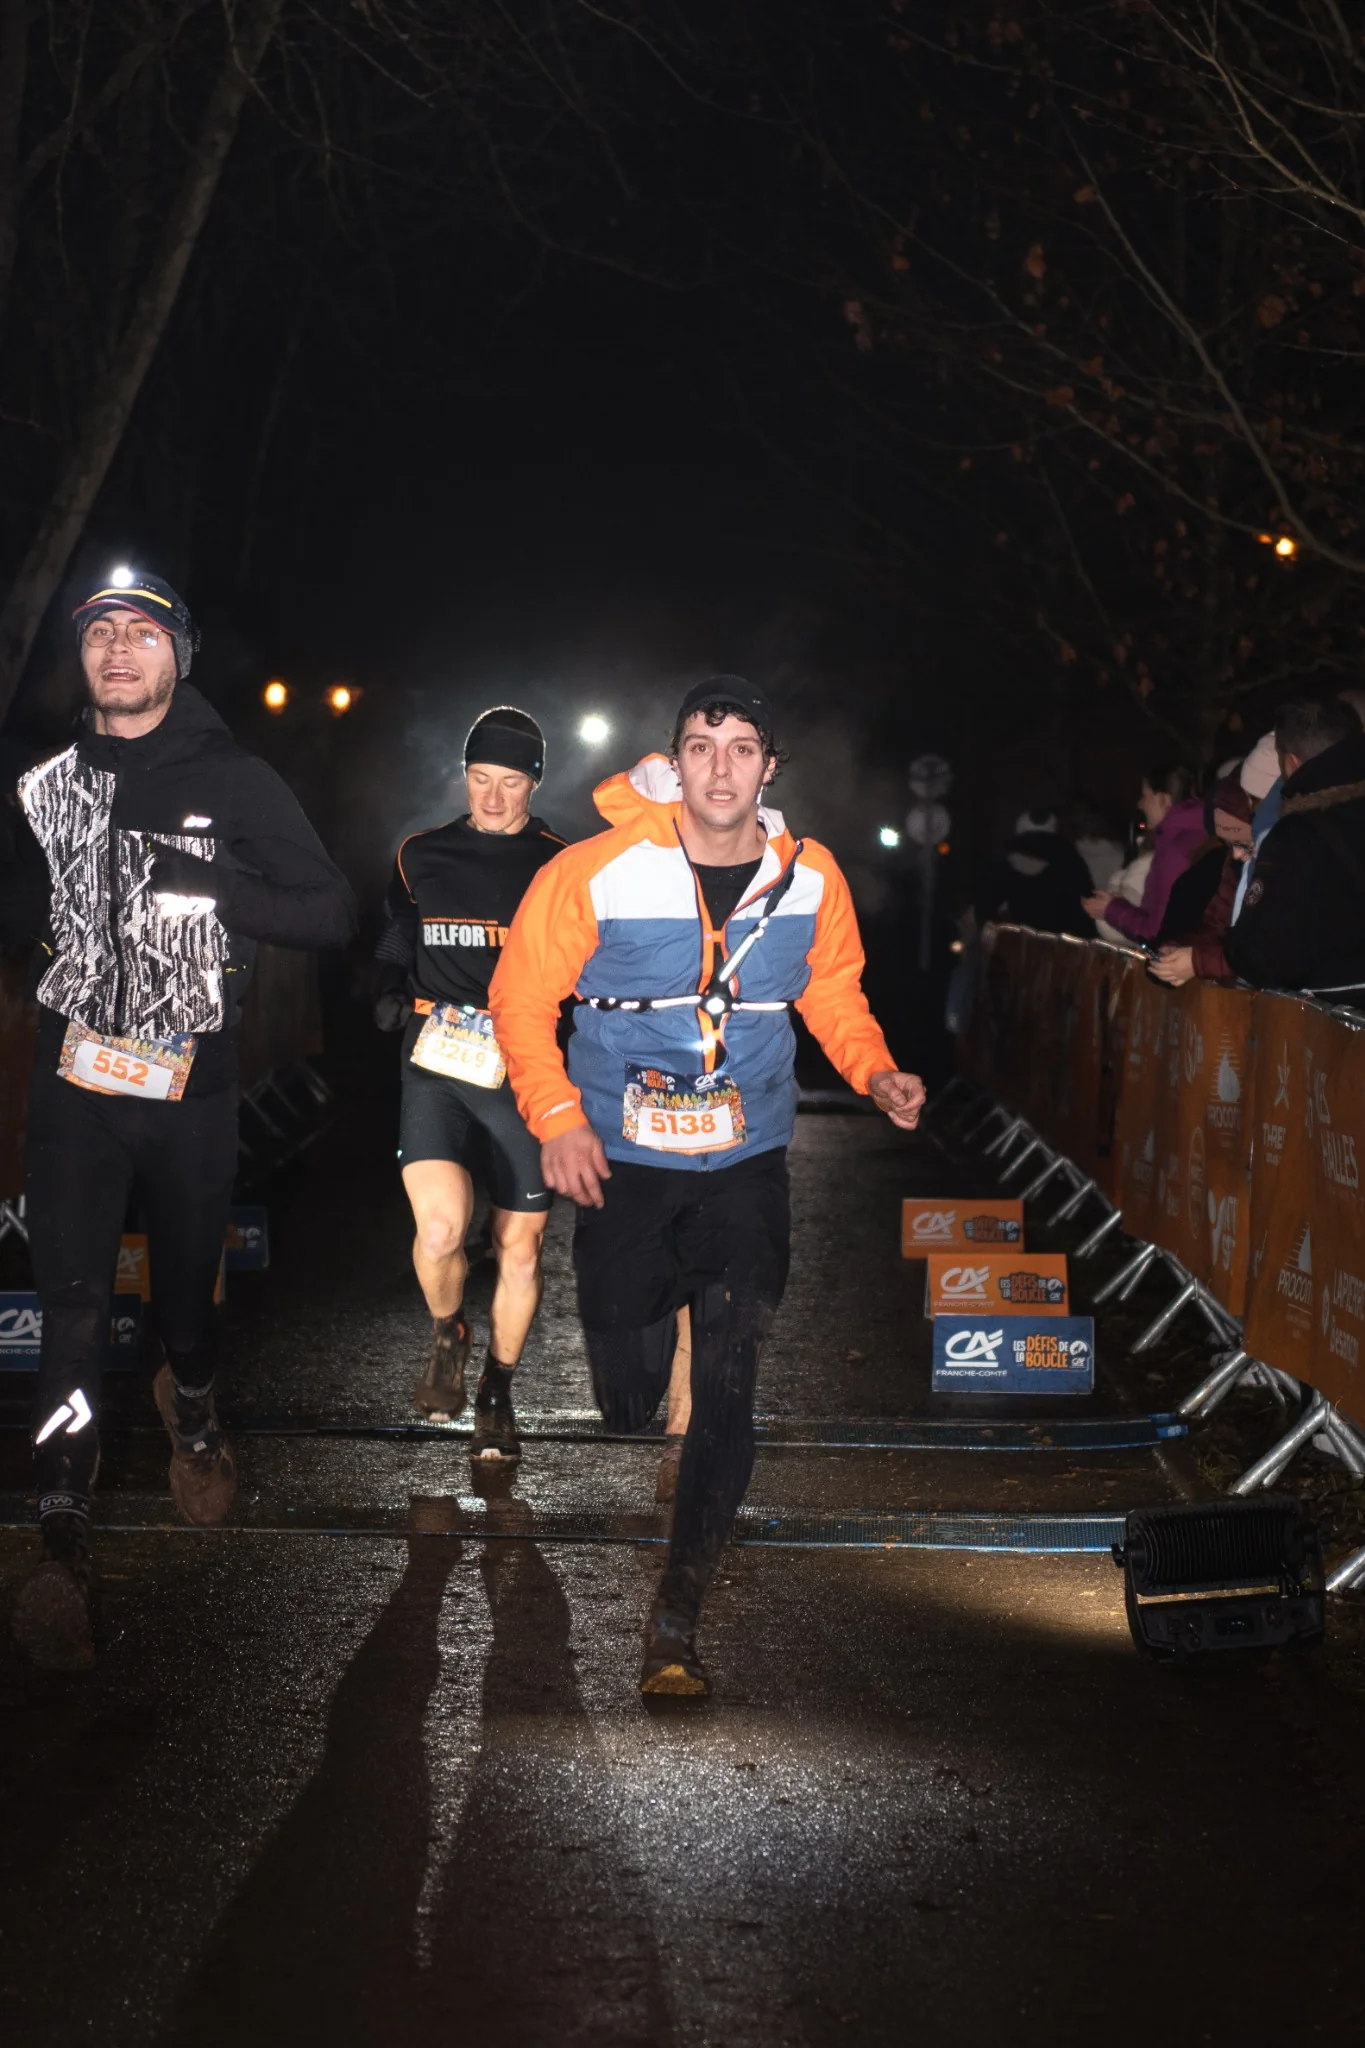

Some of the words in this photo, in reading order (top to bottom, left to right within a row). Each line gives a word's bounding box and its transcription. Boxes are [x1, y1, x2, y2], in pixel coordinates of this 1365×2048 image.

[92, 1050, 149, 1087] 552
[651, 1111, 716, 1135] 5138
[945, 1328, 1004, 1361] CA
[1012, 1339, 1026, 1352] LES
[1058, 1341, 1069, 1352] DE
[1025, 1351, 1069, 1368] BOUCLE
